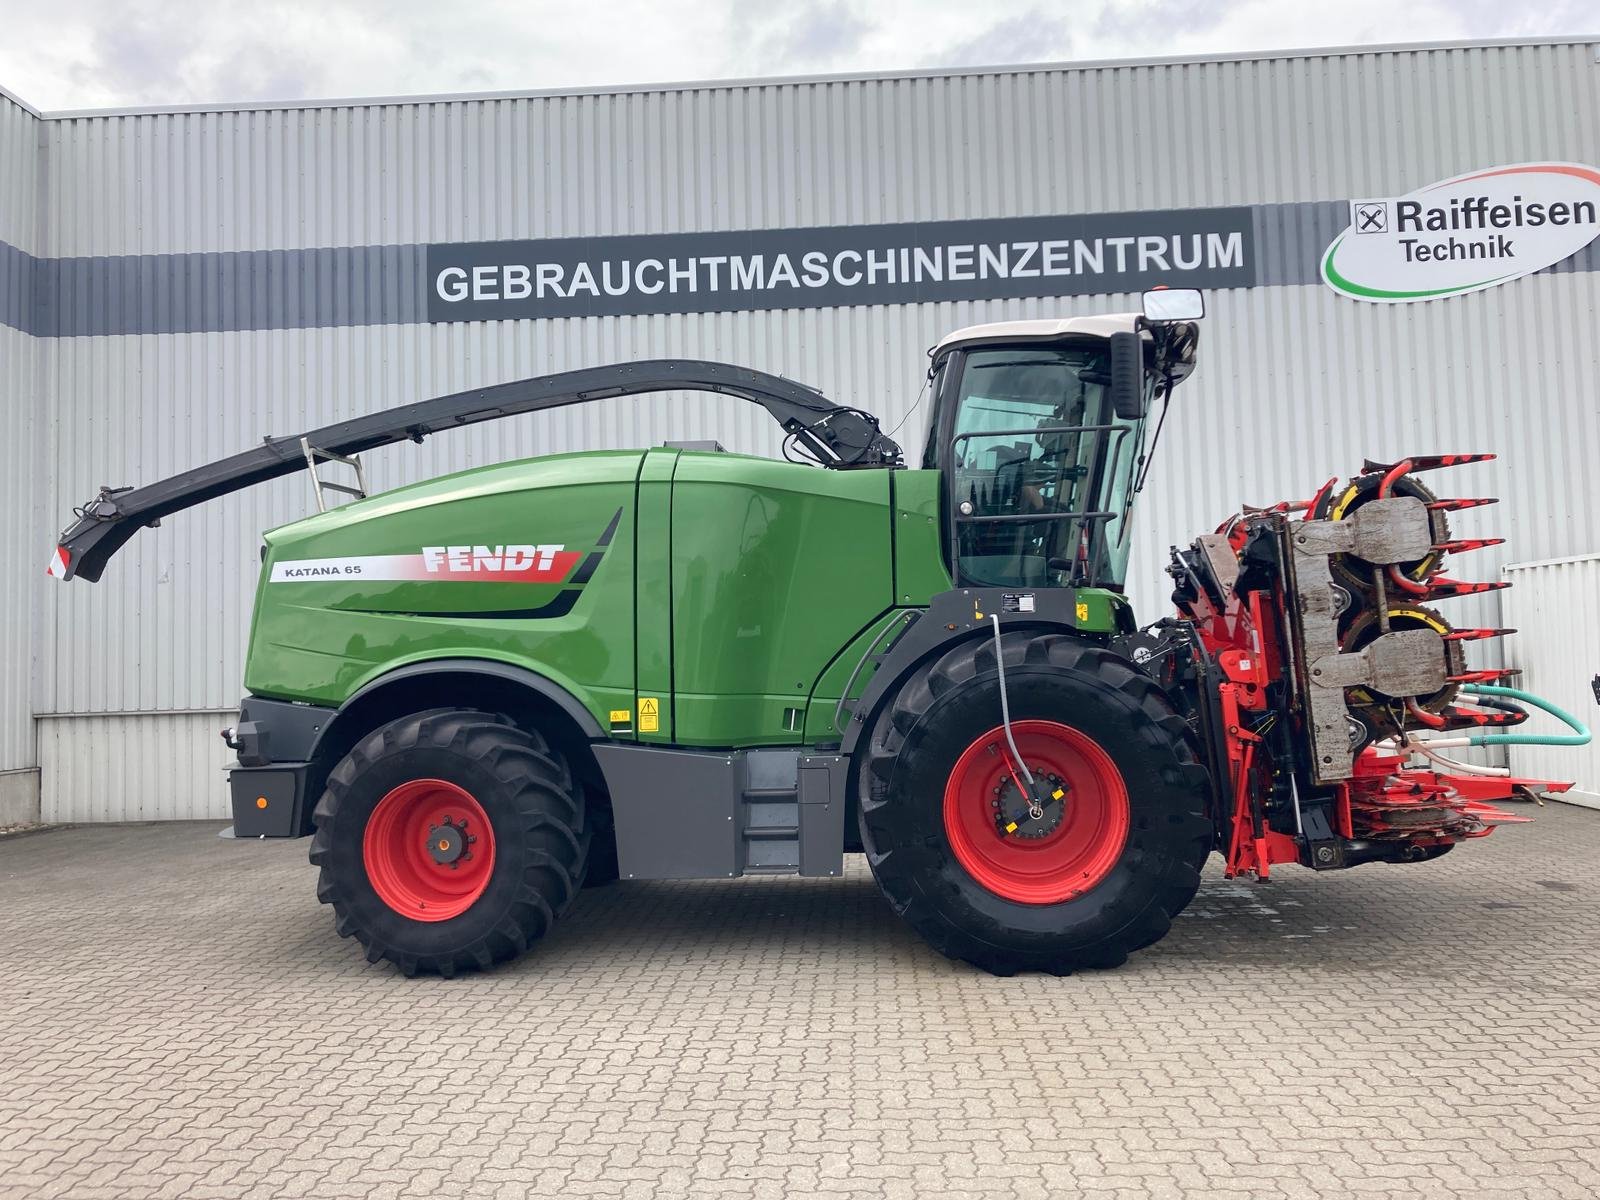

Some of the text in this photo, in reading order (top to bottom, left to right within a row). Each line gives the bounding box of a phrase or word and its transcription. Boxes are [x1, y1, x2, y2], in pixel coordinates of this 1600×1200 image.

[1396, 196, 1597, 233] Raiffeisen
[1399, 234, 1515, 262] Technik
[435, 231, 1245, 302] GEBRAUCHTMASCHINENZENTRUM
[284, 565, 362, 577] KATANA 65
[422, 544, 565, 572] FENDT
